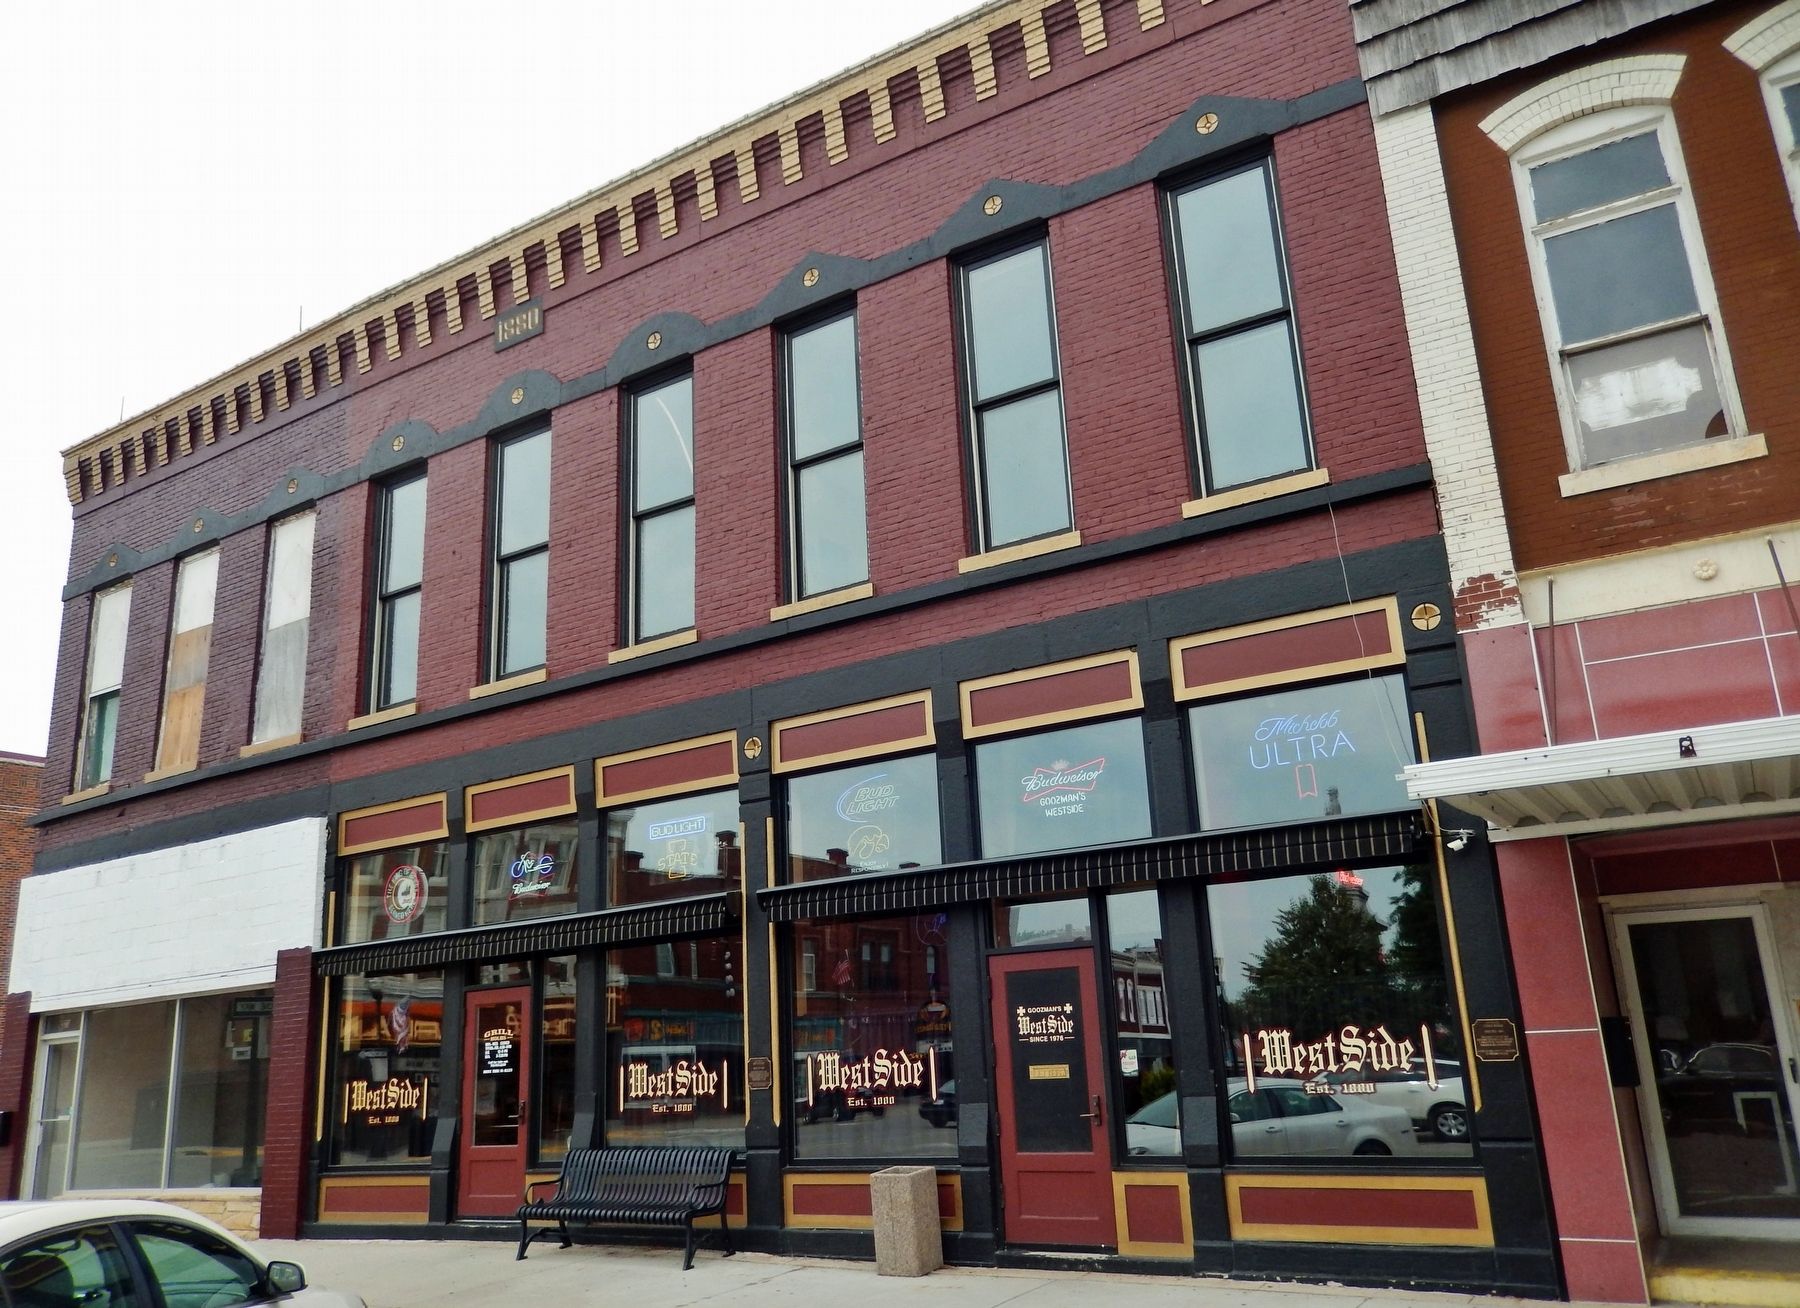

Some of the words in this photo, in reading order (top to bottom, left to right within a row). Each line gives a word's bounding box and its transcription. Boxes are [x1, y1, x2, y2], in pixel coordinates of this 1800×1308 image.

[498, 308, 539, 343] 1880
[1249, 730, 1357, 769] ULTRA
[1021, 769, 1104, 792] Budweiser
[855, 785, 894, 801] BUD
[1039, 791, 1087, 807] GOOZMAN'S
[846, 795, 900, 814] LIGHT
[1045, 803, 1085, 817] WESTSIDE
[651, 825, 673, 837] BUD
[674, 820, 702, 833] LIGHT
[657, 851, 698, 871] STATE
[1027, 1005, 1062, 1014] GOOZMAN'S
[484, 1028, 513, 1038] GRILL
[1304, 1082, 1335, 1095] Est.
[652, 1103, 670, 1114] Est.
[847, 1097, 868, 1107] Est.
